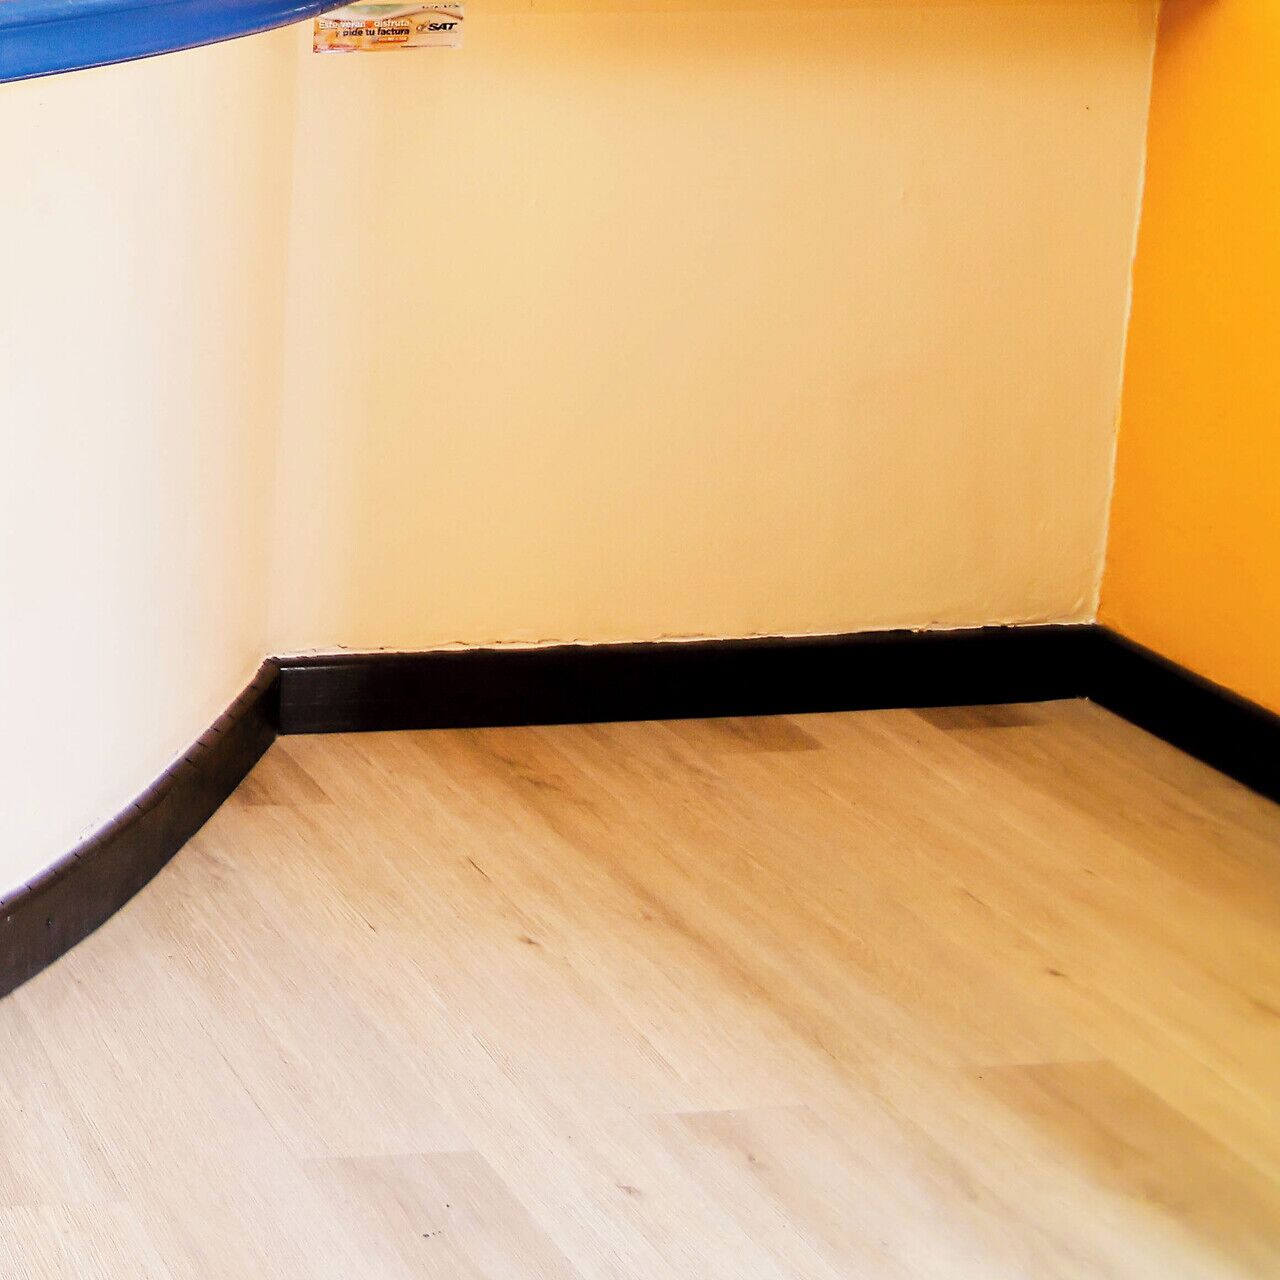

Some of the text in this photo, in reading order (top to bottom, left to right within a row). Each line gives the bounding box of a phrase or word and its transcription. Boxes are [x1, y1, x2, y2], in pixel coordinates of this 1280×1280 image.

[428, 22, 458, 31] SAT
[343, 28, 363, 37] pide
[377, 27, 410, 36] factura
